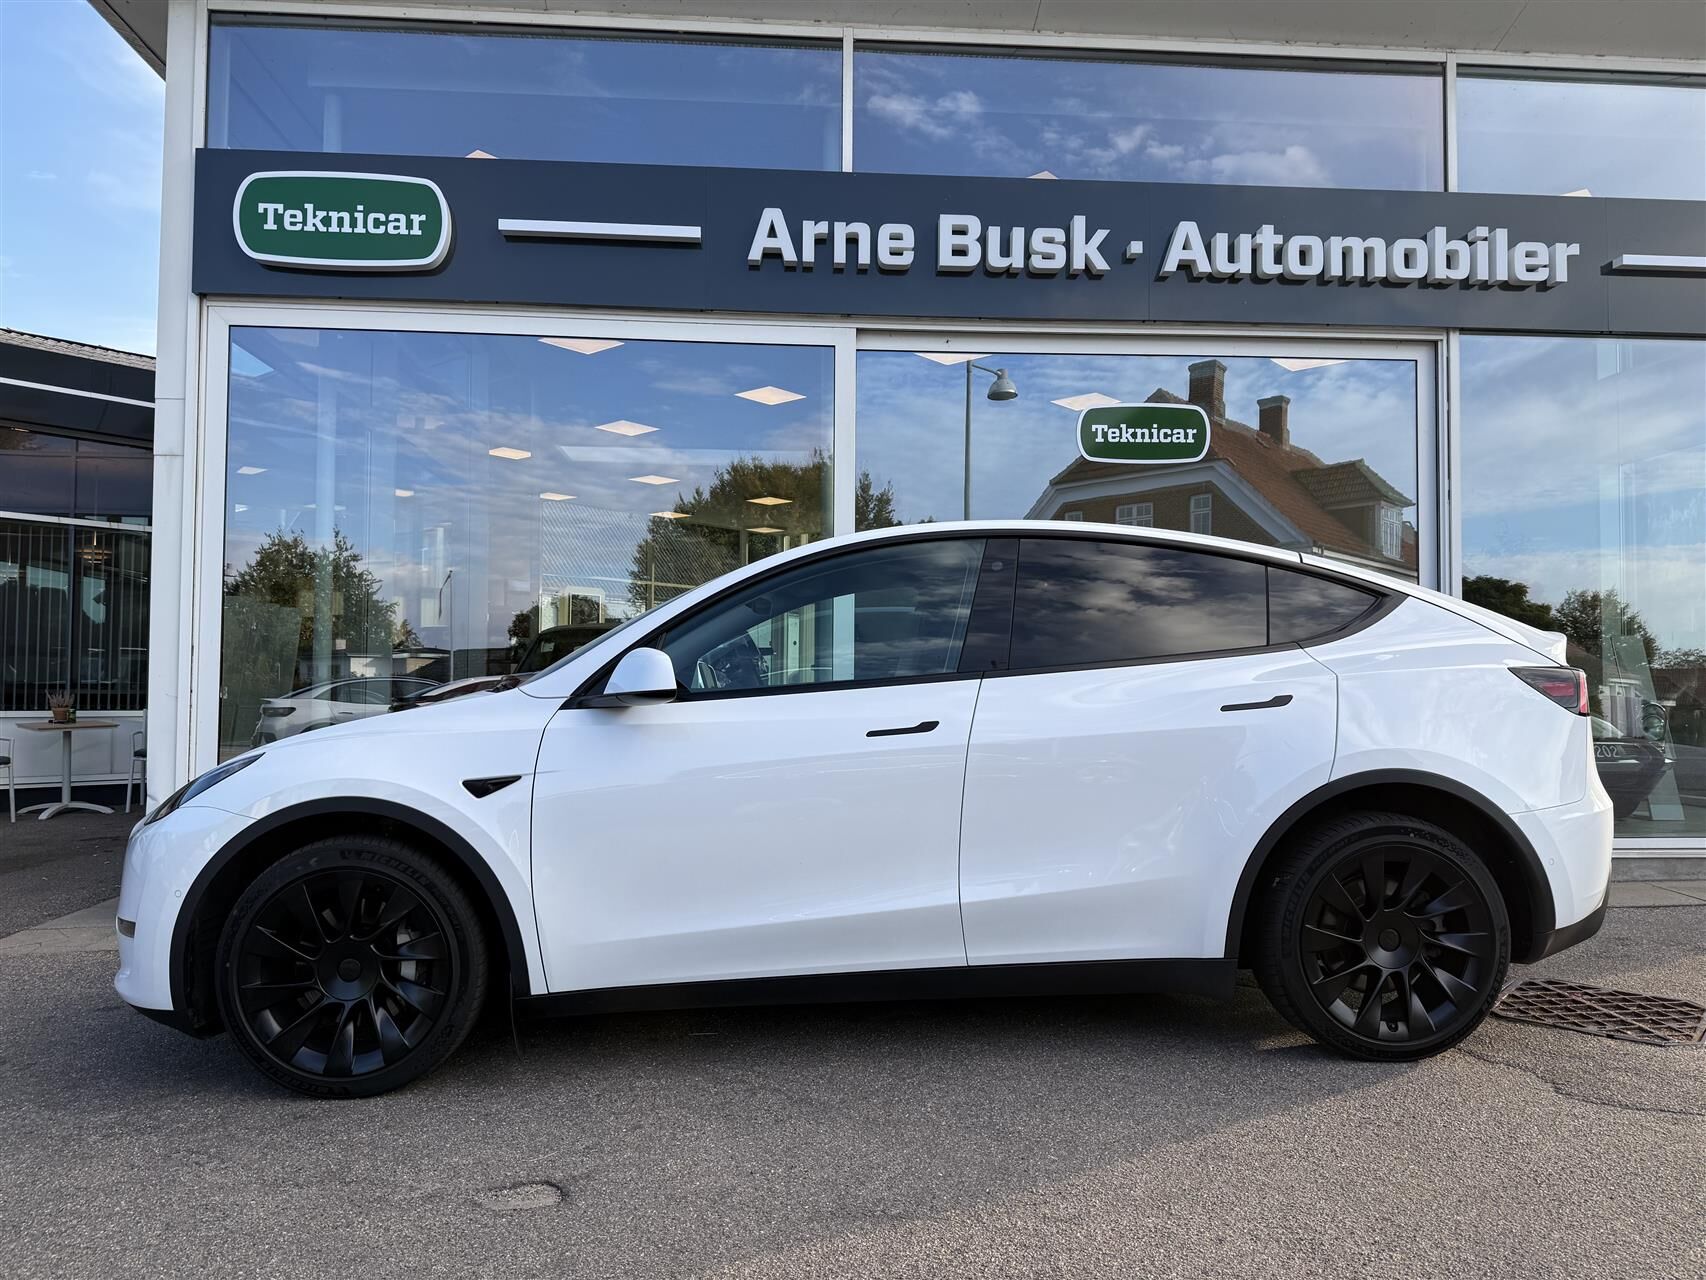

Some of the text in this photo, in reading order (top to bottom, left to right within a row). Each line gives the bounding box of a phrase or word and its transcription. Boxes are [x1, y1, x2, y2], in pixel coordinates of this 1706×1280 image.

[258, 202, 426, 236] Teknicar
[748, 207, 915, 270] Arne
[937, 213, 1110, 276] Busk
[1160, 220, 1580, 285] Automobiler
[1092, 424, 1197, 443] Teknicar
[359, 851, 430, 886] MICHELIN
